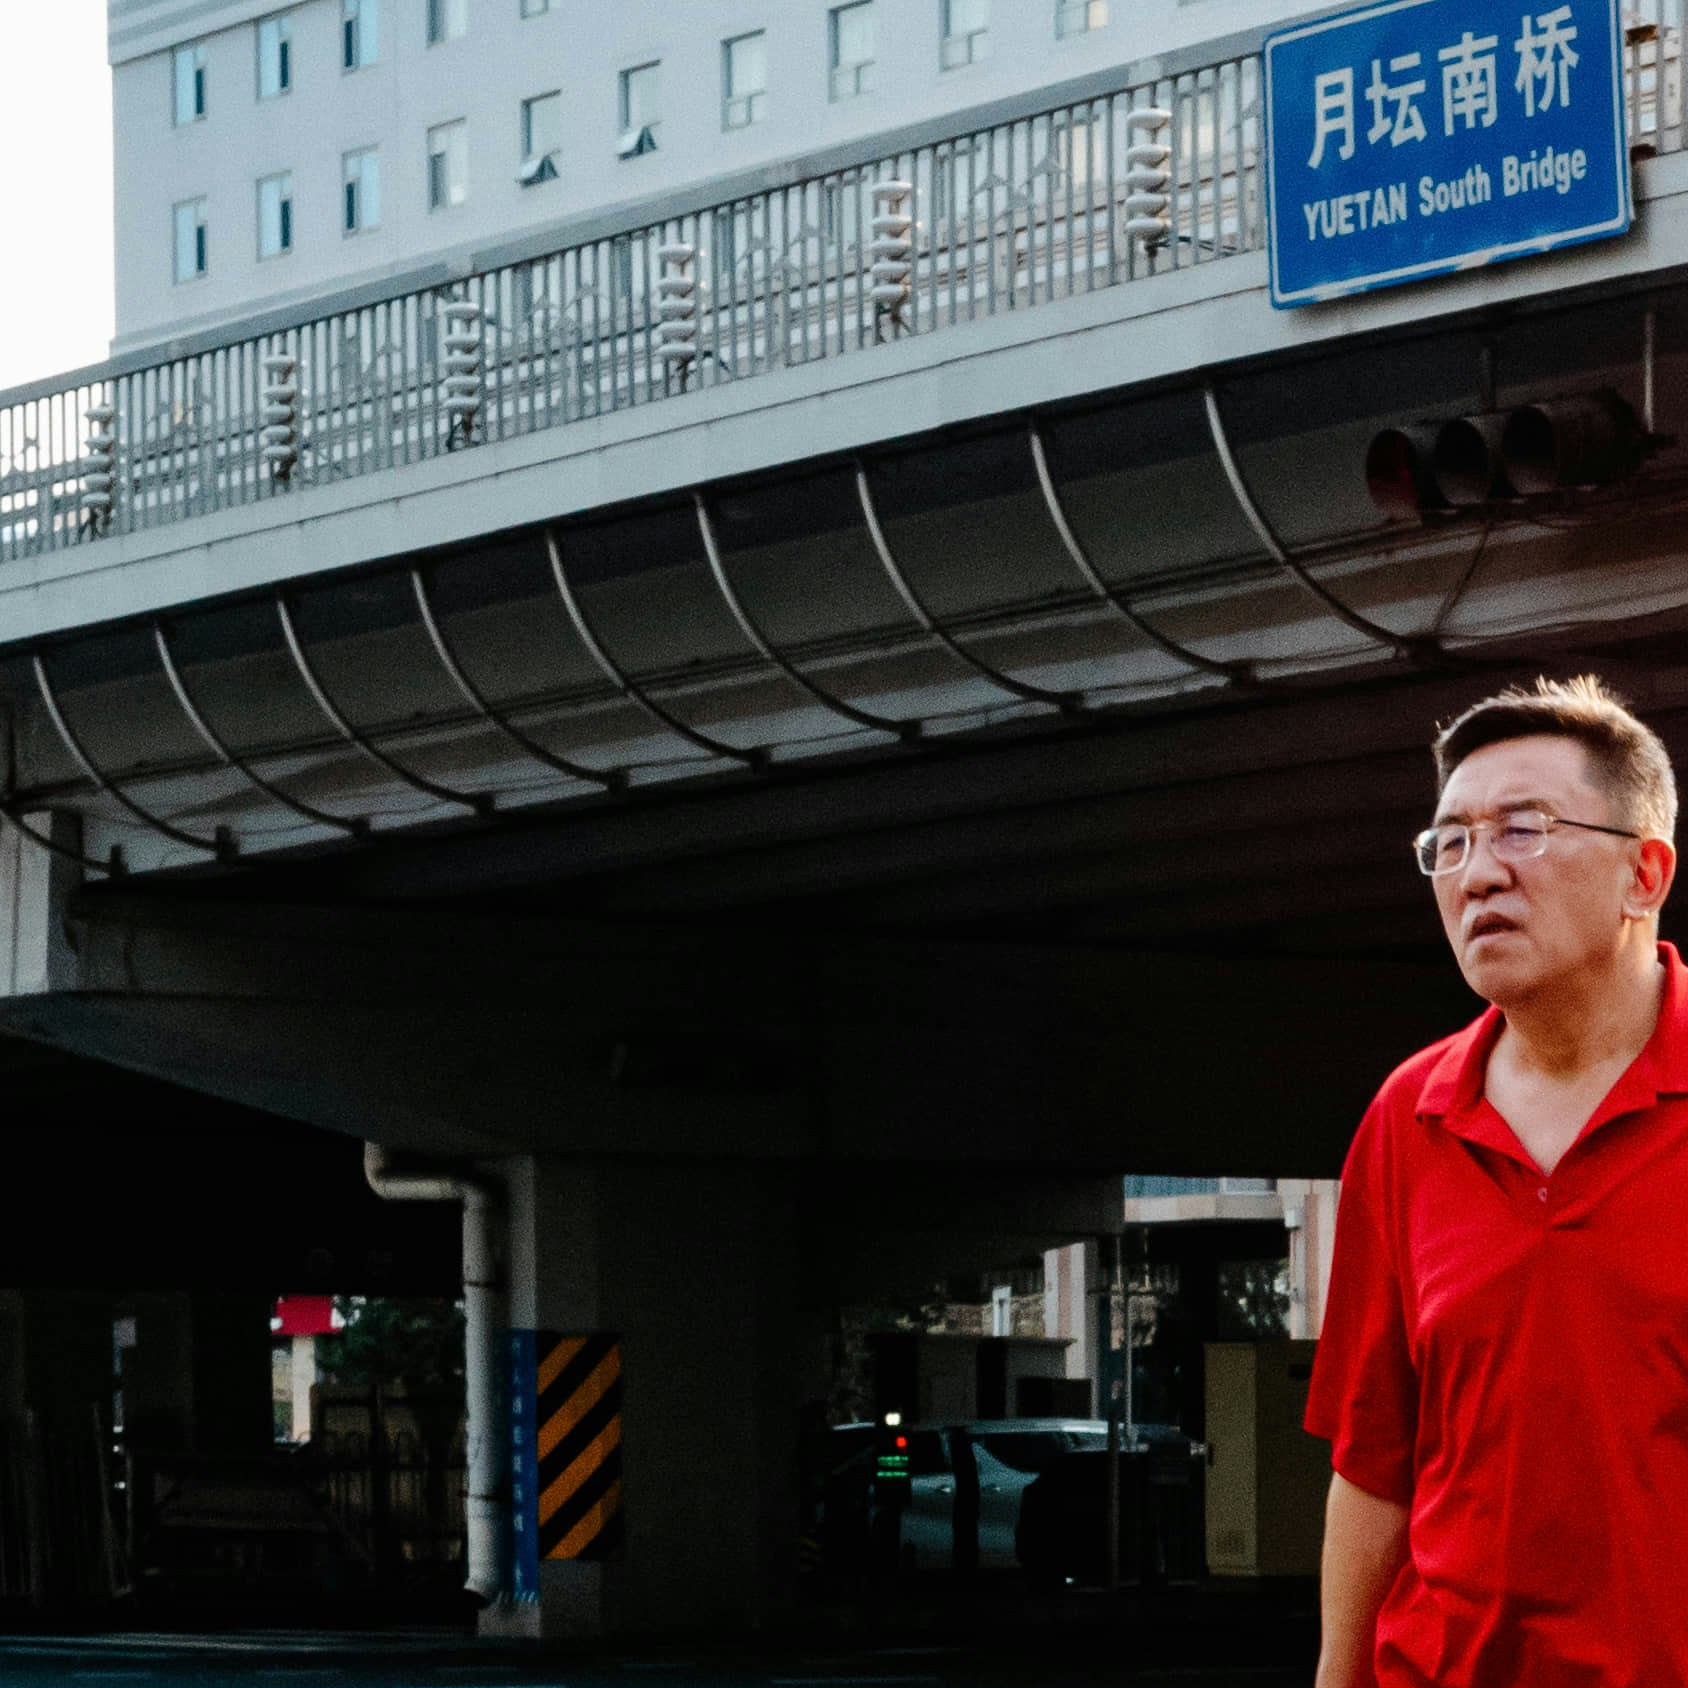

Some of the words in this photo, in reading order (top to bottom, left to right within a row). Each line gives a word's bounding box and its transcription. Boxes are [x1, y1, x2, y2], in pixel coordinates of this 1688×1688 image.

[1308, 5, 1580, 169] 月坛南桥
[1304, 182, 1407, 241] YUETAN
[1418, 164, 1491, 217] South
[1502, 146, 1587, 197] Bridge
